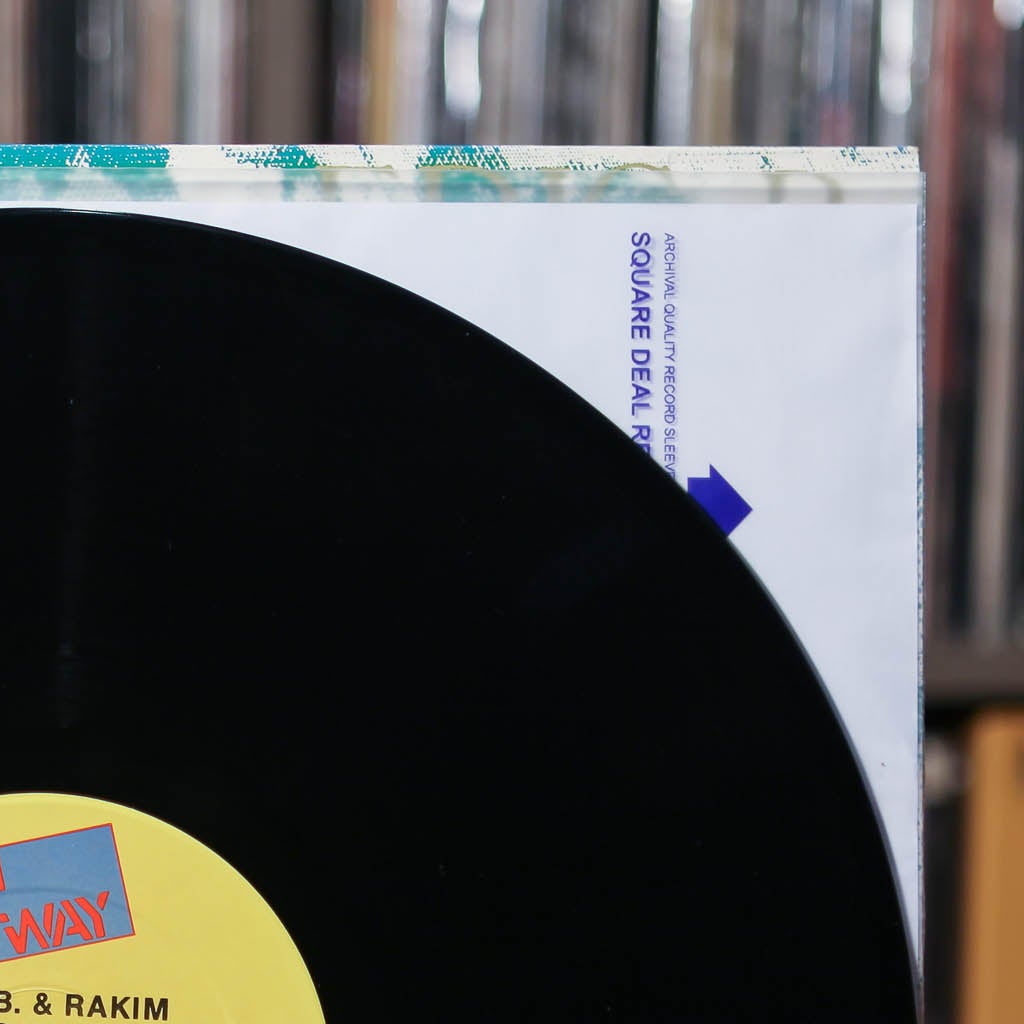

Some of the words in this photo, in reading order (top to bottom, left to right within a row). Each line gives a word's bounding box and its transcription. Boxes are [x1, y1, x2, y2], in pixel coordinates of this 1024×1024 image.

[631, 231, 652, 339] SQUARE
[664, 232, 676, 300] ARCHIVAL
[664, 303, 676, 362] QUALITY
[631, 348, 652, 416] DEAL
[664, 365, 676, 424] RECORD
[33, 992, 52, 1015] &
[65, 993, 168, 1021] RAKIM
